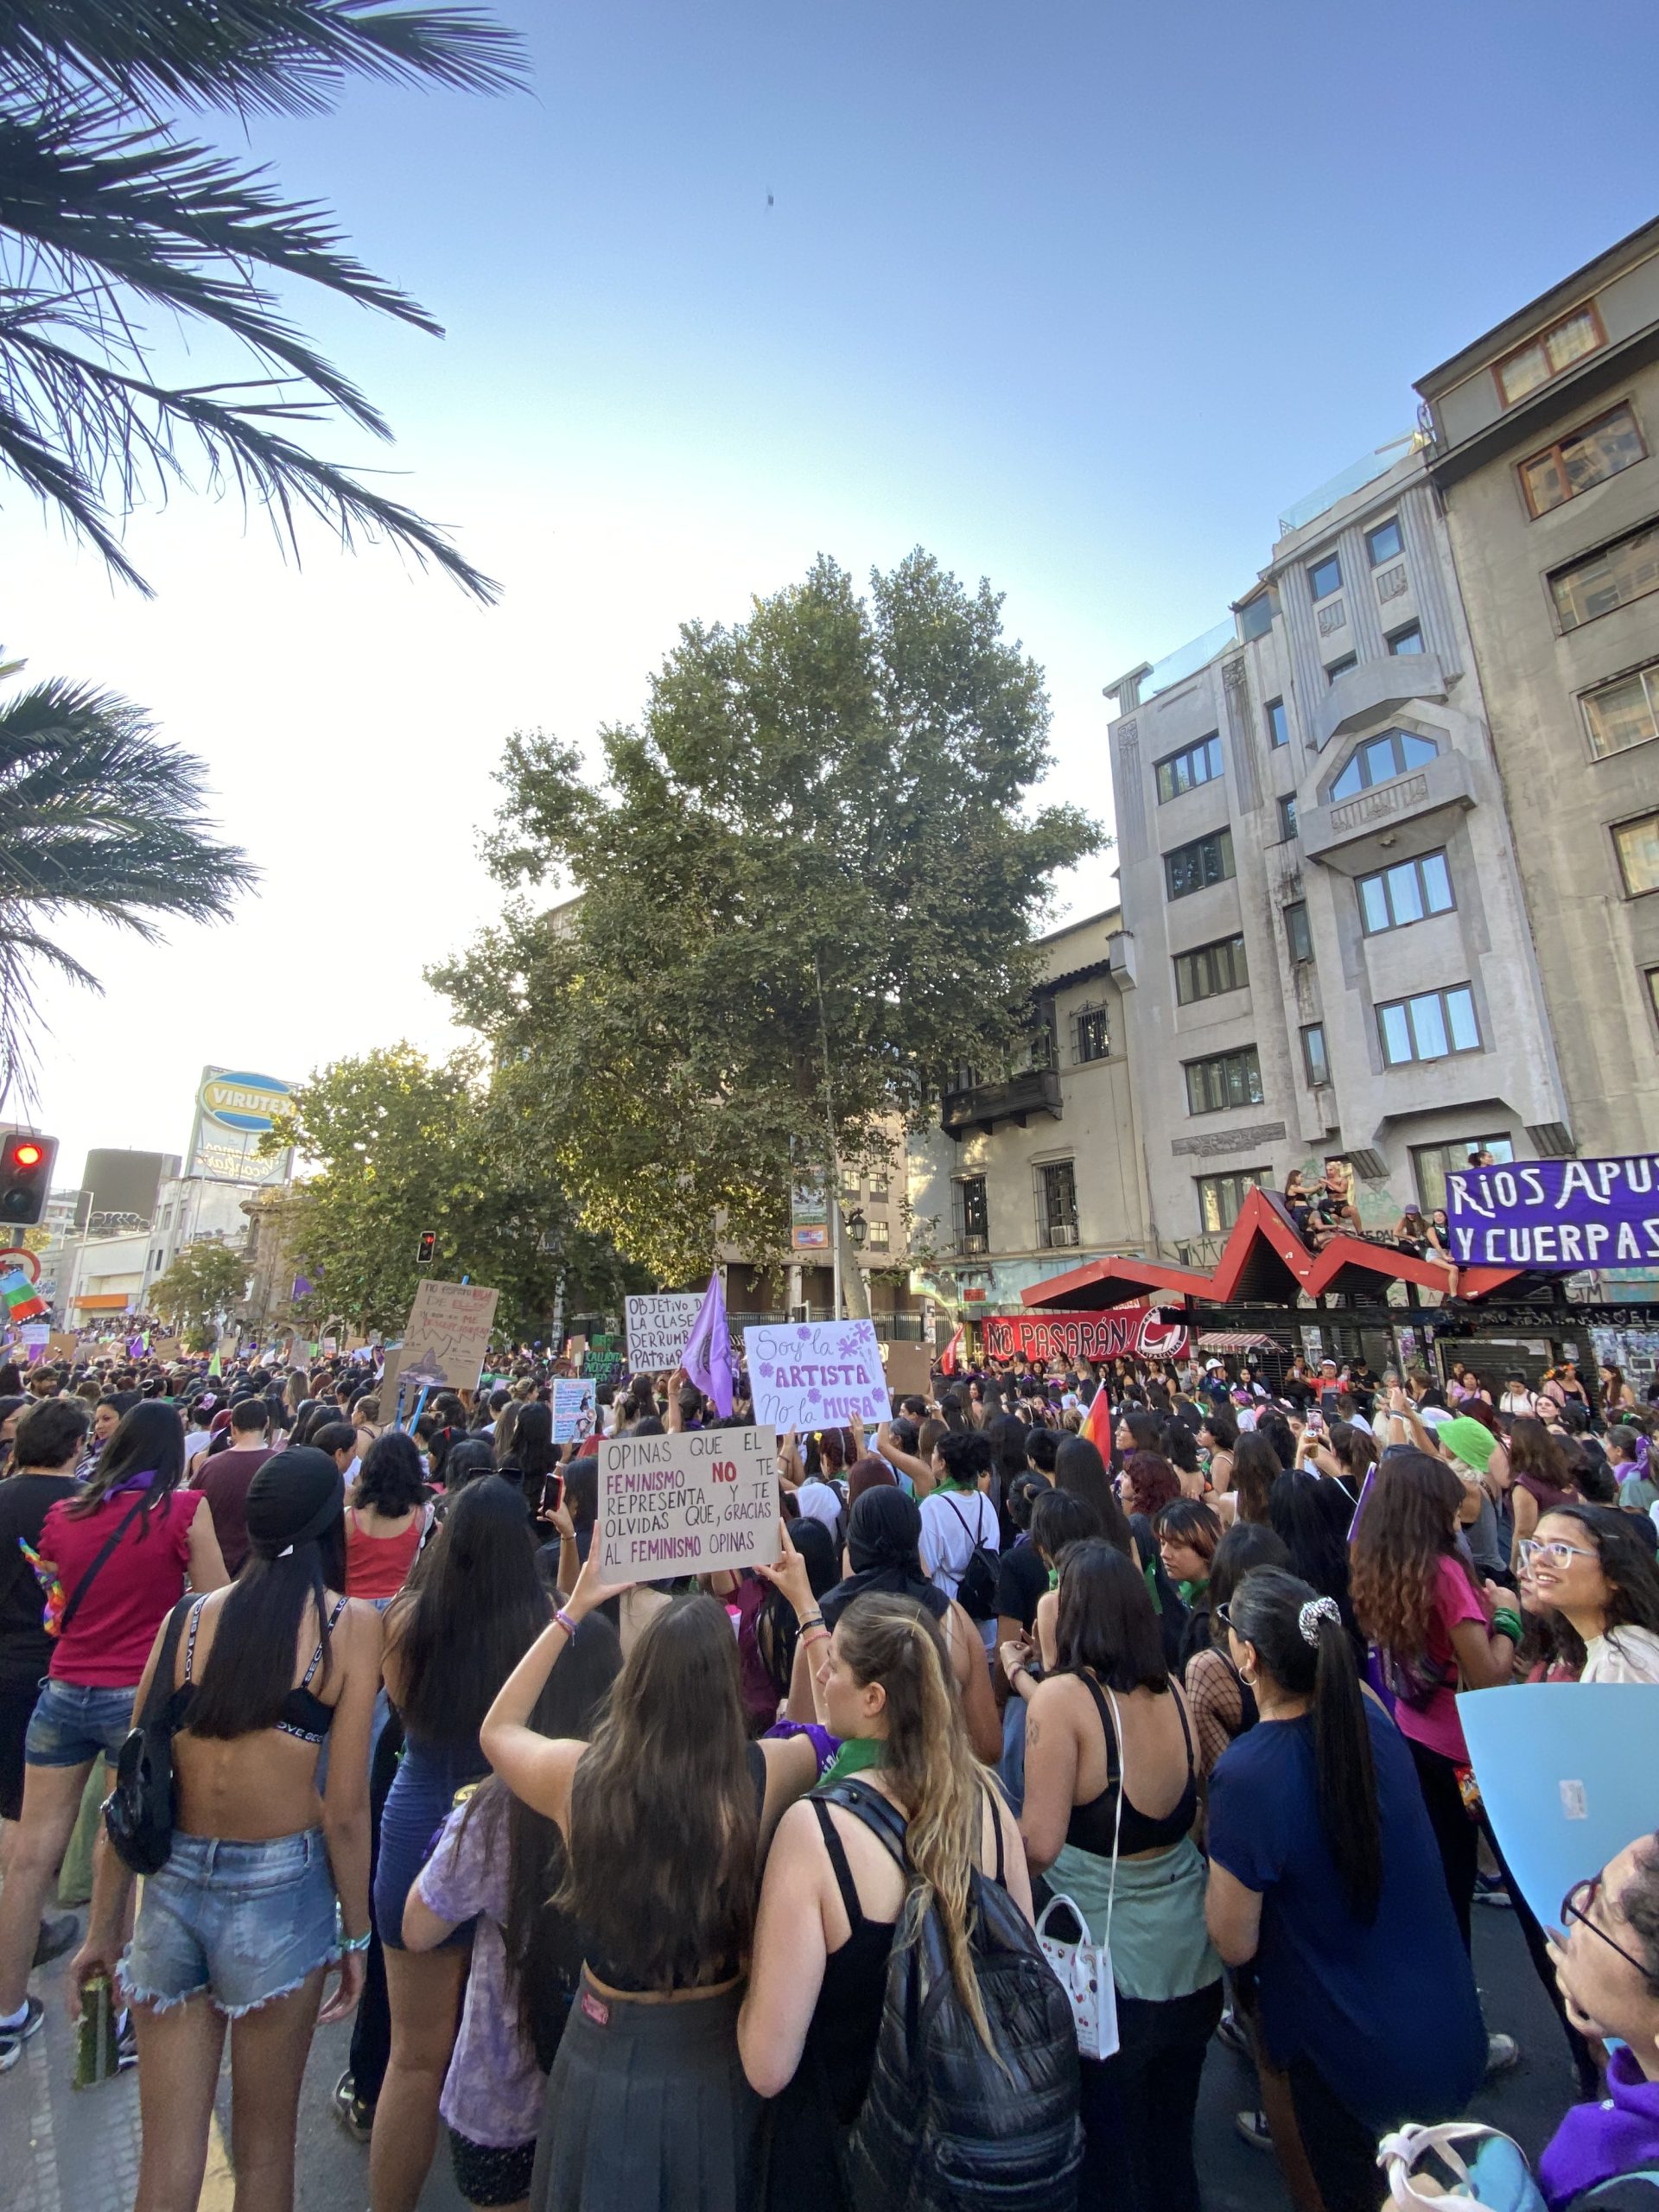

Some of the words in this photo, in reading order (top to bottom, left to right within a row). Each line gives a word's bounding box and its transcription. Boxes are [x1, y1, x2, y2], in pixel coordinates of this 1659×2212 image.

[213, 1087, 292, 1116] VIRUTEX
[1554, 1159, 1659, 1210] APU
[1455, 1228, 1474, 1261] Y
[695, 1299, 704, 1311] D
[631, 1317, 646, 1331] LA
[654, 1313, 695, 1329] CLASE
[629, 1330, 689, 1349] DERRUMB
[756, 1329, 804, 1363] Soy
[810, 1328, 835, 1357] la
[988, 1322, 1014, 1357] NO
[775, 1364, 871, 1388] ARTISTA
[761, 1393, 794, 1426] No
[799, 1397, 817, 1425] la
[823, 1396, 877, 1420] MUSA
[608, 1441, 671, 1471] OPINAS
[690, 1436, 722, 1457] QUE
[744, 1433, 762, 1451] EL
[607, 1470, 685, 1495] FEMINISMO
[712, 1461, 736, 1484] NO
[756, 1458, 774, 1476] TE
[607, 1488, 705, 1516] REPRESENTA
[729, 1485, 739, 1502] Y
[752, 1482, 769, 1499] TE
[605, 1512, 669, 1538] OLVIDAS
[685, 1505, 721, 1527] QUE,
[724, 1503, 772, 1522] GRACIAS
[605, 1542, 621, 1566] AL
[631, 1535, 701, 1563] FEMINISMO
[709, 1531, 754, 1554] OPINAS
[336, 1597, 347, 1611] LO
[276, 1720, 305, 1737] OVE
[305, 1732, 323, 1743] SEC
